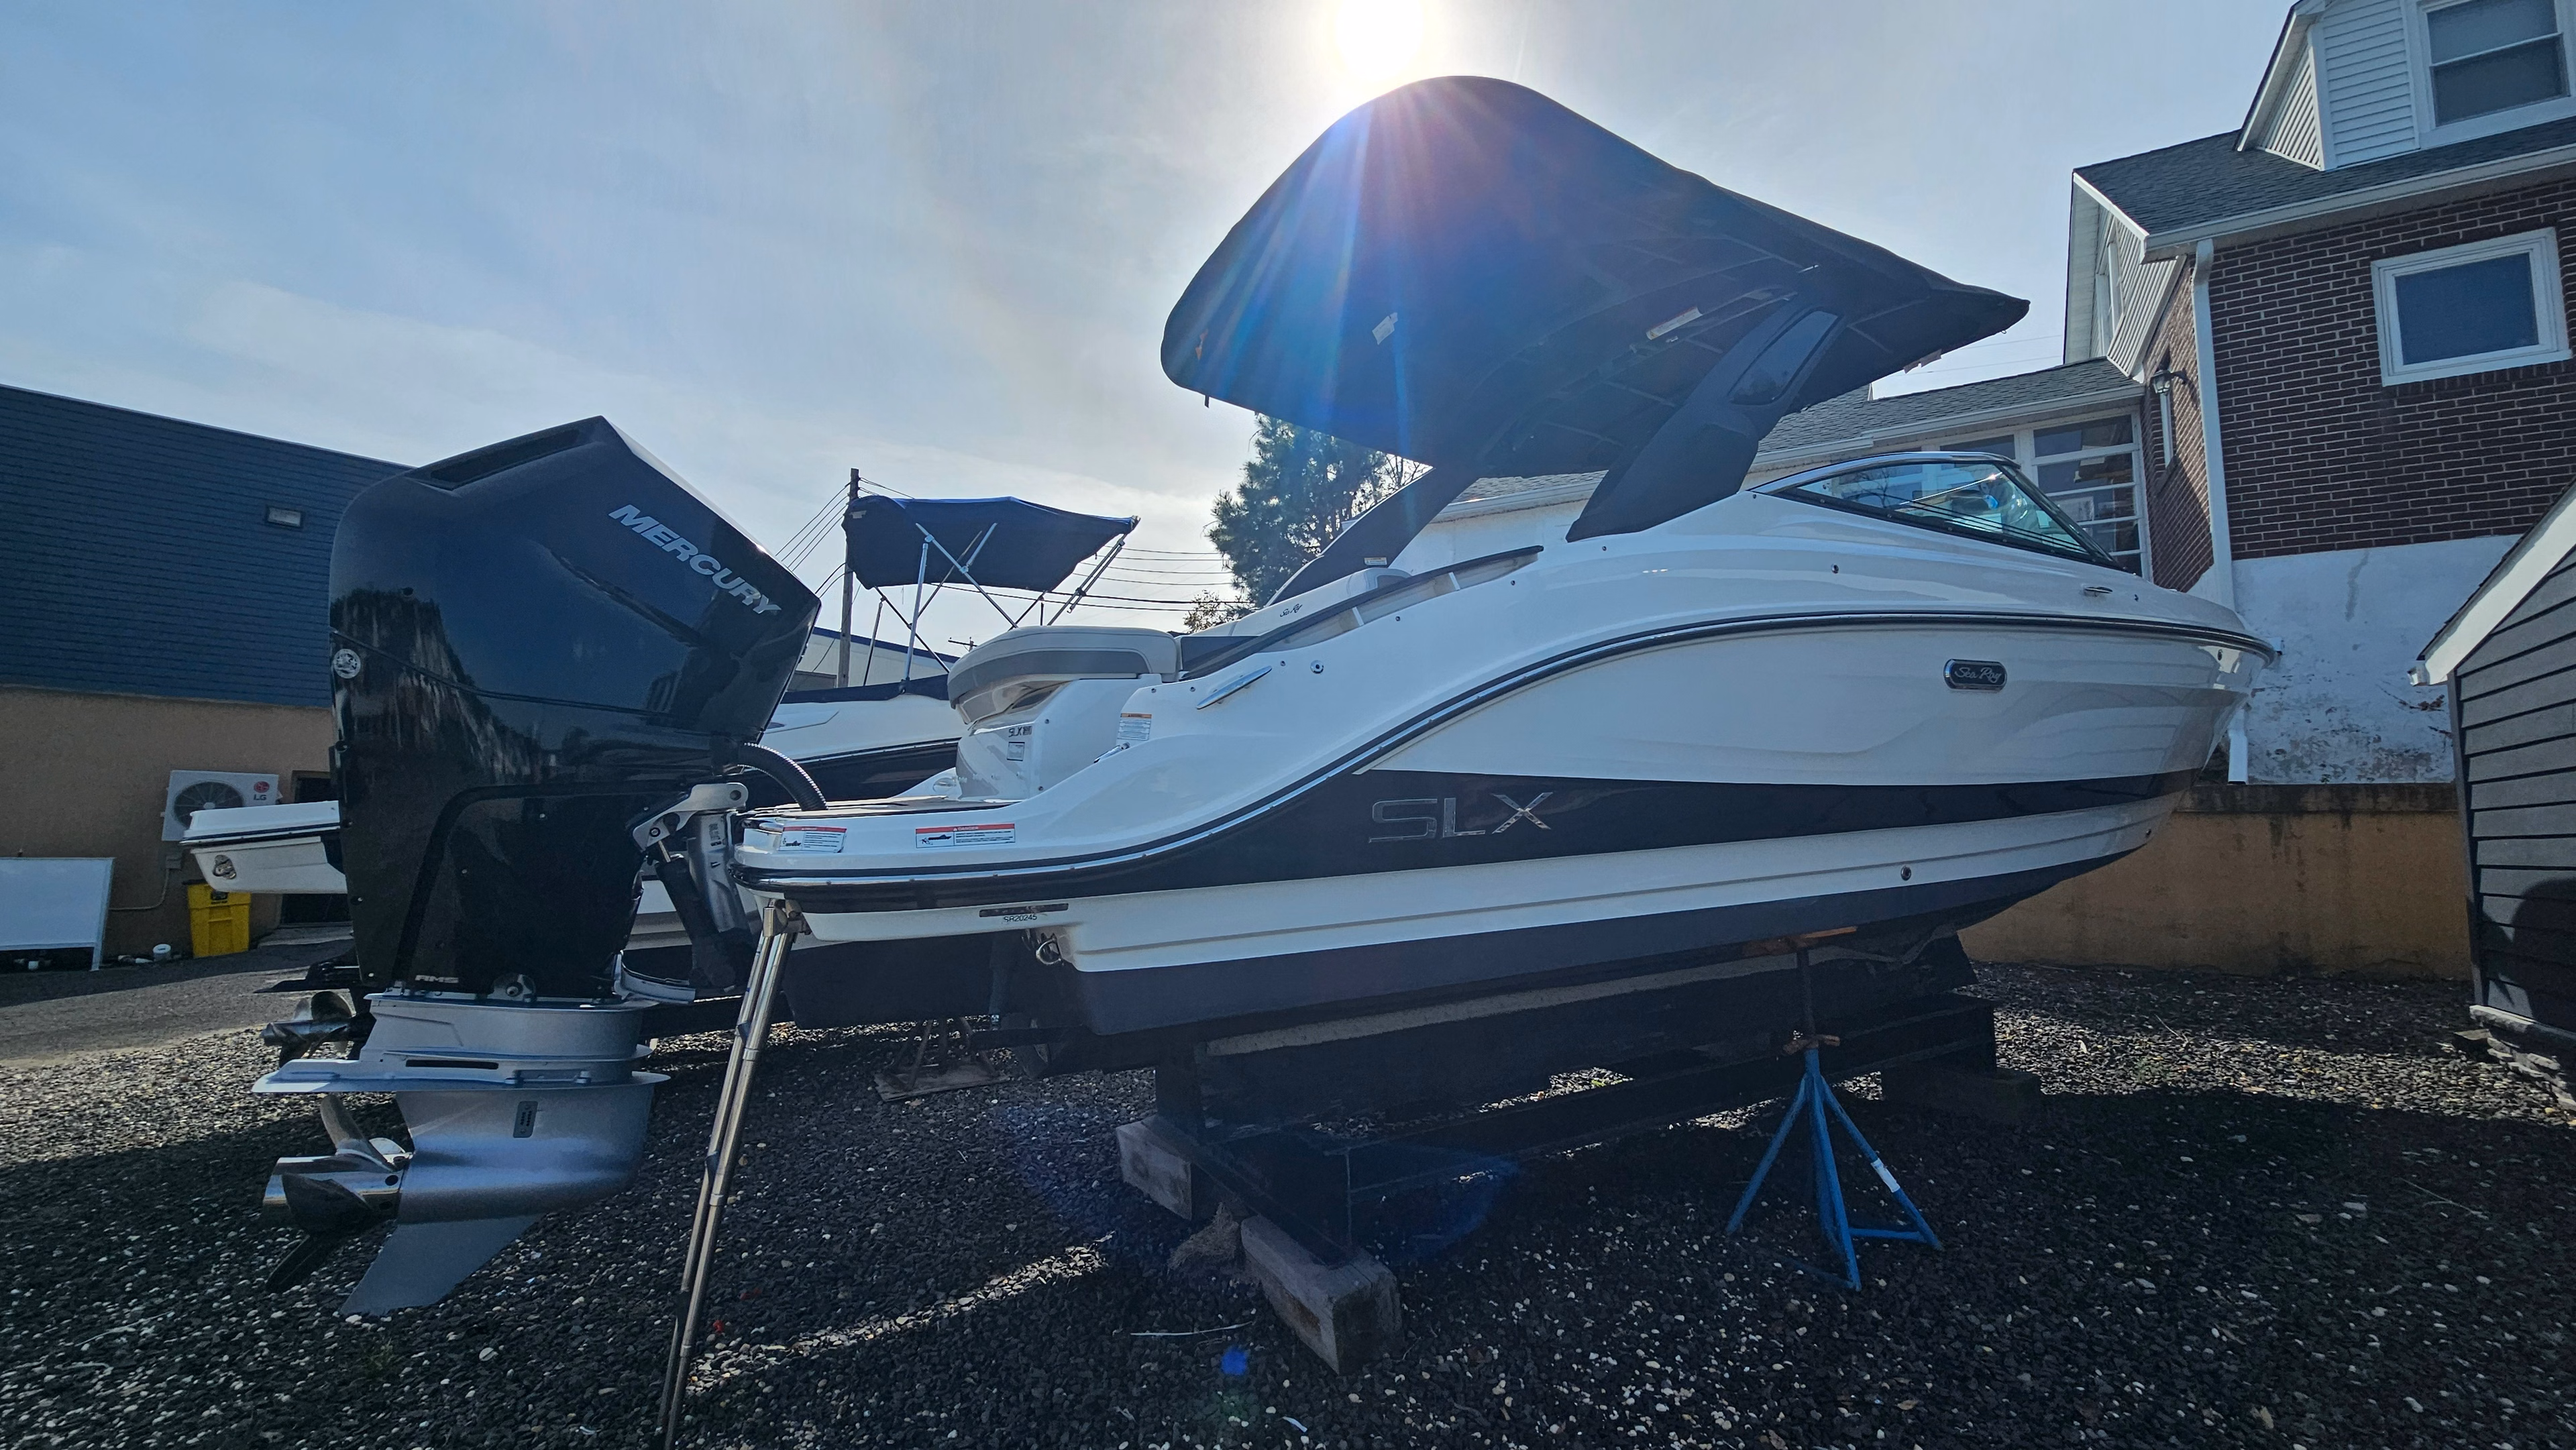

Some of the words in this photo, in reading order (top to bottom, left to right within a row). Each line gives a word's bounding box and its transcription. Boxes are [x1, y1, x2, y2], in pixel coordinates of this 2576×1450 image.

[608, 504, 782, 614] MERCURY
[1954, 667, 1978, 679] Sea
[1978, 667, 2002, 683] Ray
[1368, 791, 1554, 843] SLX
